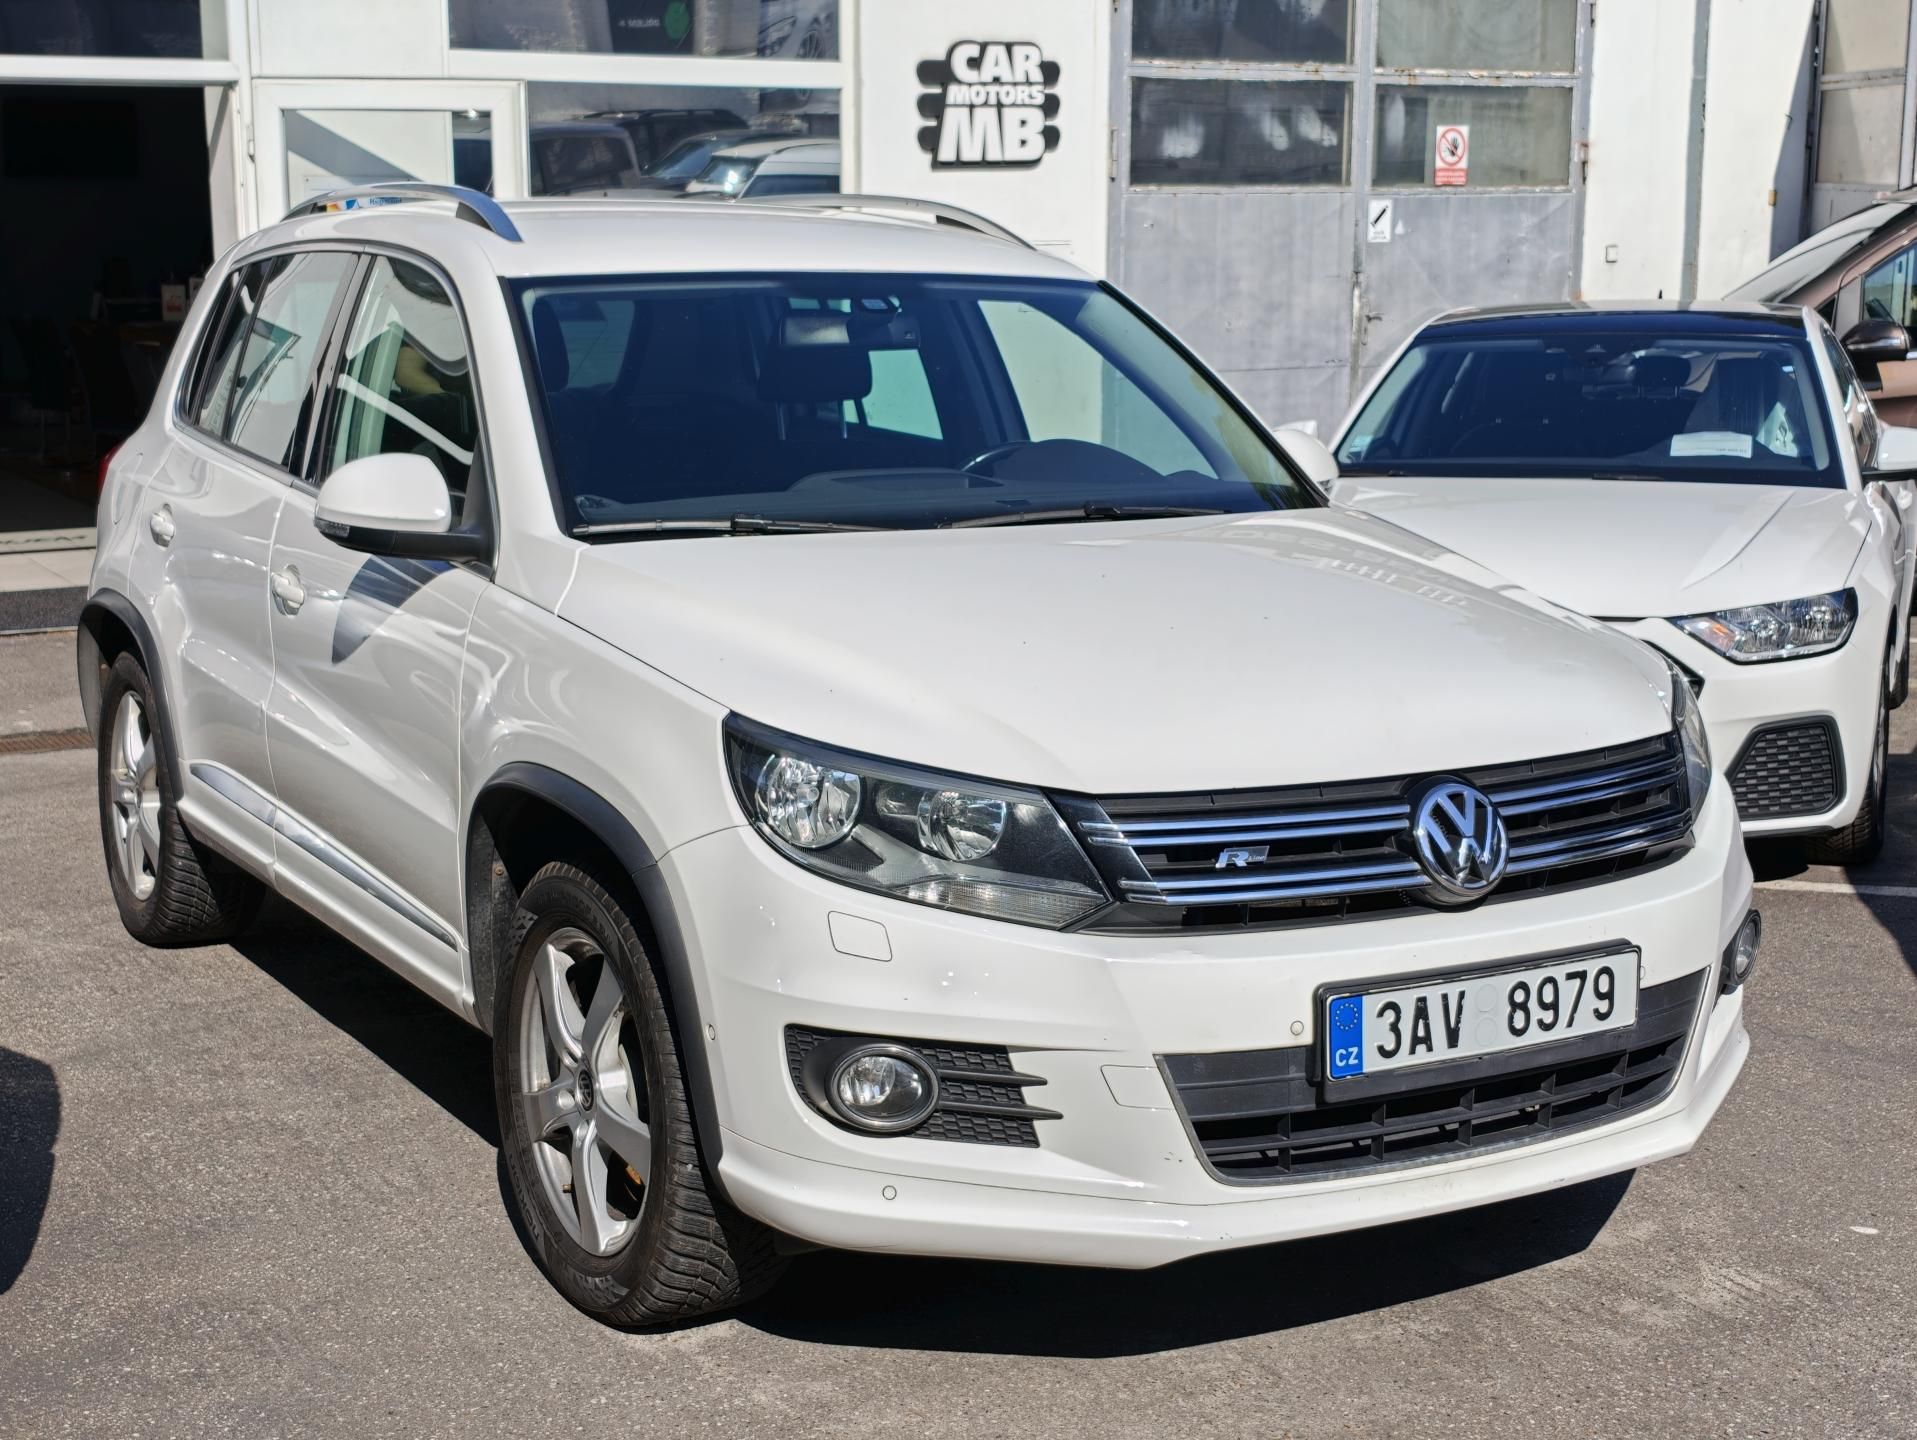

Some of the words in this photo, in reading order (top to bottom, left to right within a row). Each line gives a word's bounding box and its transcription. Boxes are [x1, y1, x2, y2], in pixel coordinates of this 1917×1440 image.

[949, 41, 1045, 83] CAR
[945, 84, 1046, 106] MOTORS
[936, 105, 1046, 163] MB
[1375, 989, 1467, 1060] 3AV
[1506, 966, 1616, 1038] 8979
[1334, 1046, 1360, 1068] CZ
